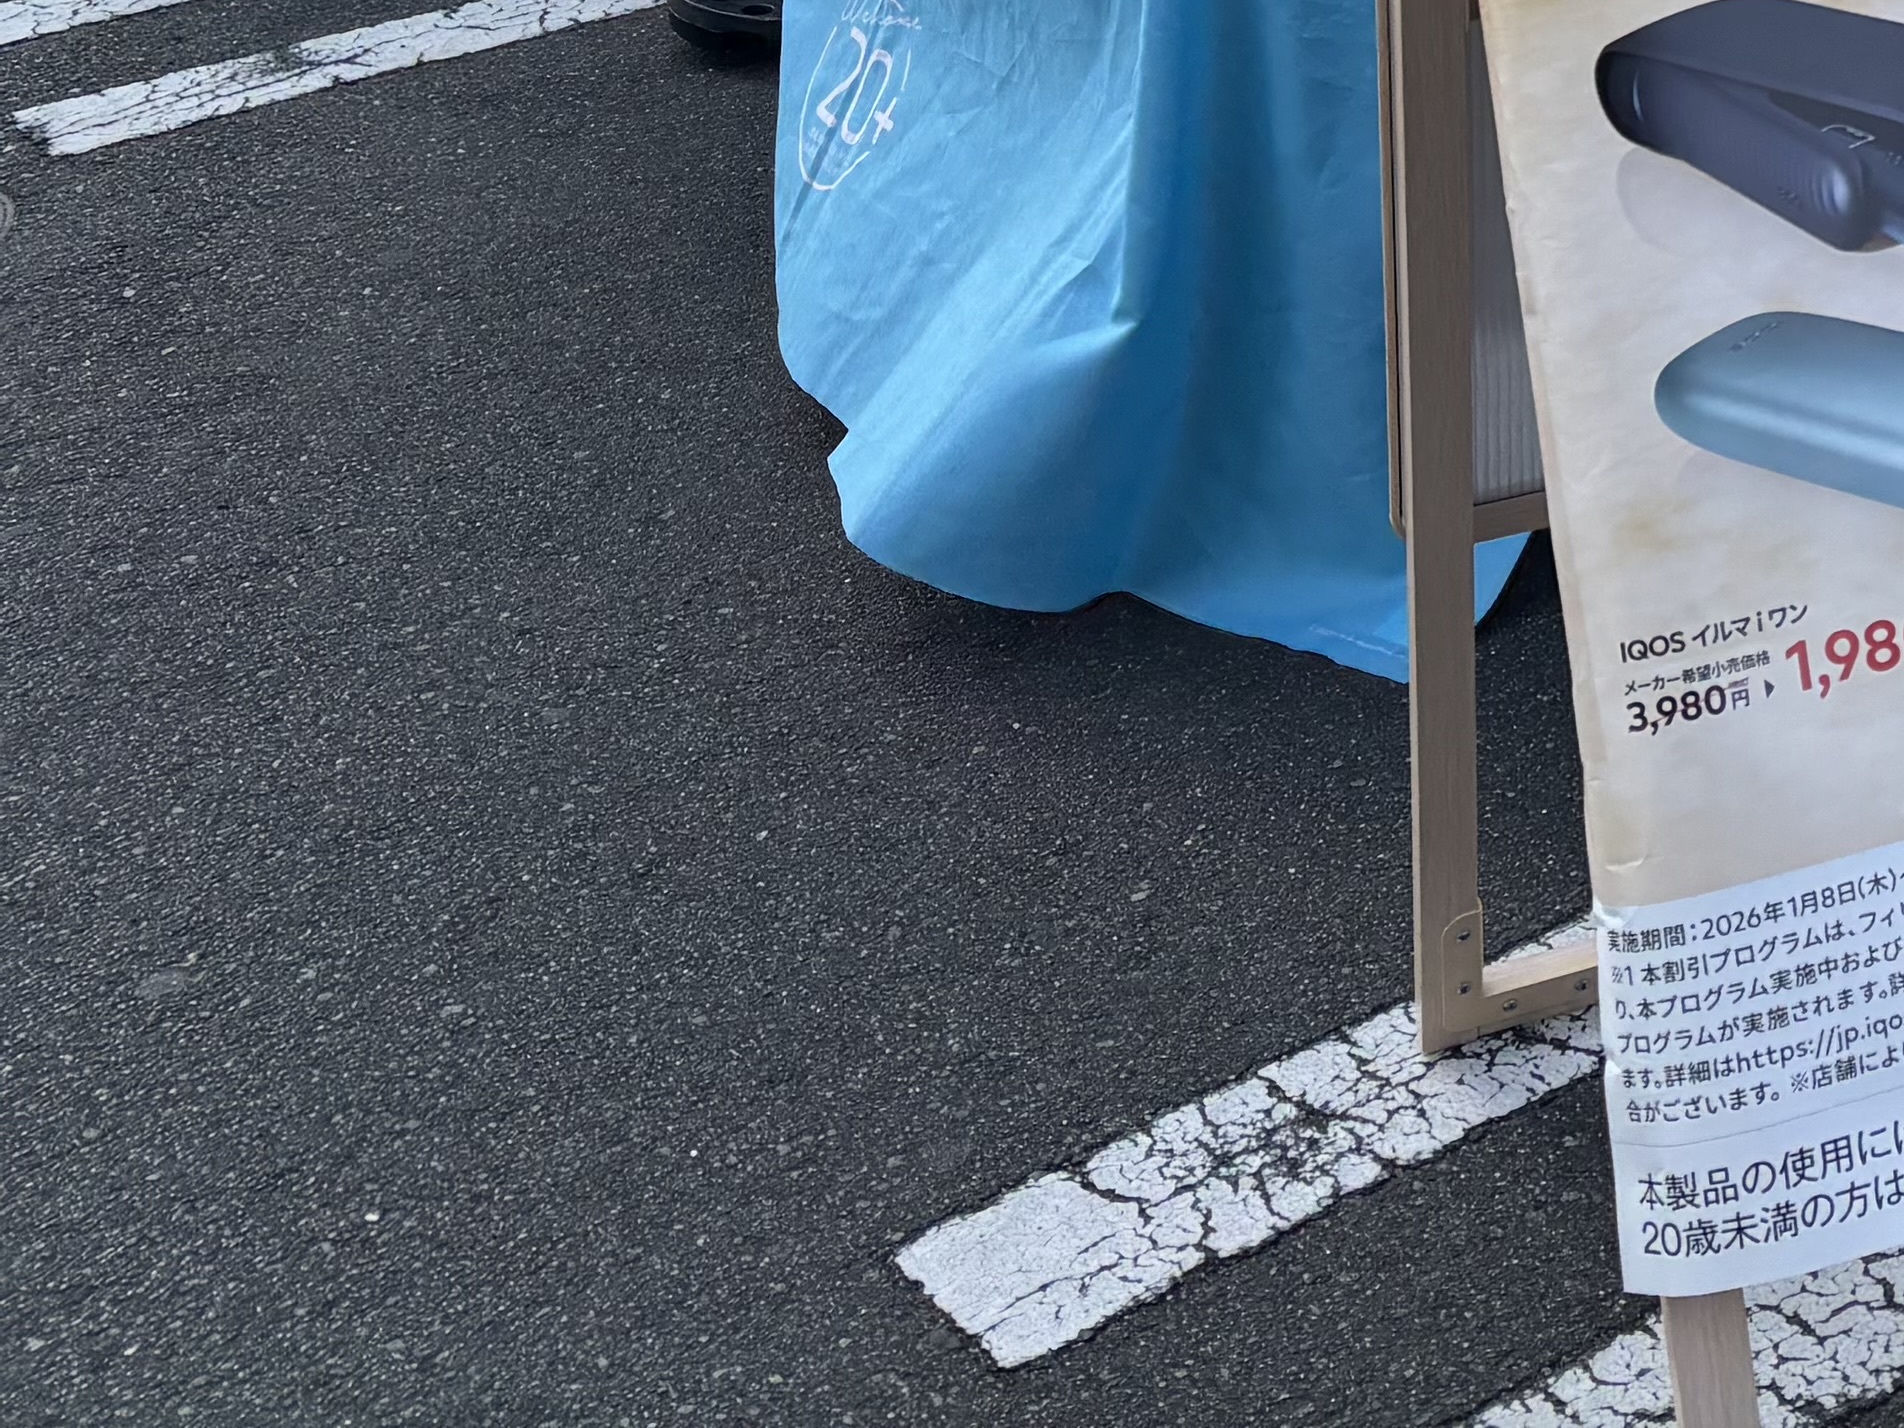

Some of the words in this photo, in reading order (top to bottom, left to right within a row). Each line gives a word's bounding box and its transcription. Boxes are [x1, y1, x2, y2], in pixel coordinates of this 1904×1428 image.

[816, 26, 897, 146] 20+
[1620, 631, 1686, 663] IQOS
[1768, 604, 1808, 629] ワン
[1624, 650, 1771, 695] メーカー希望小売価格
